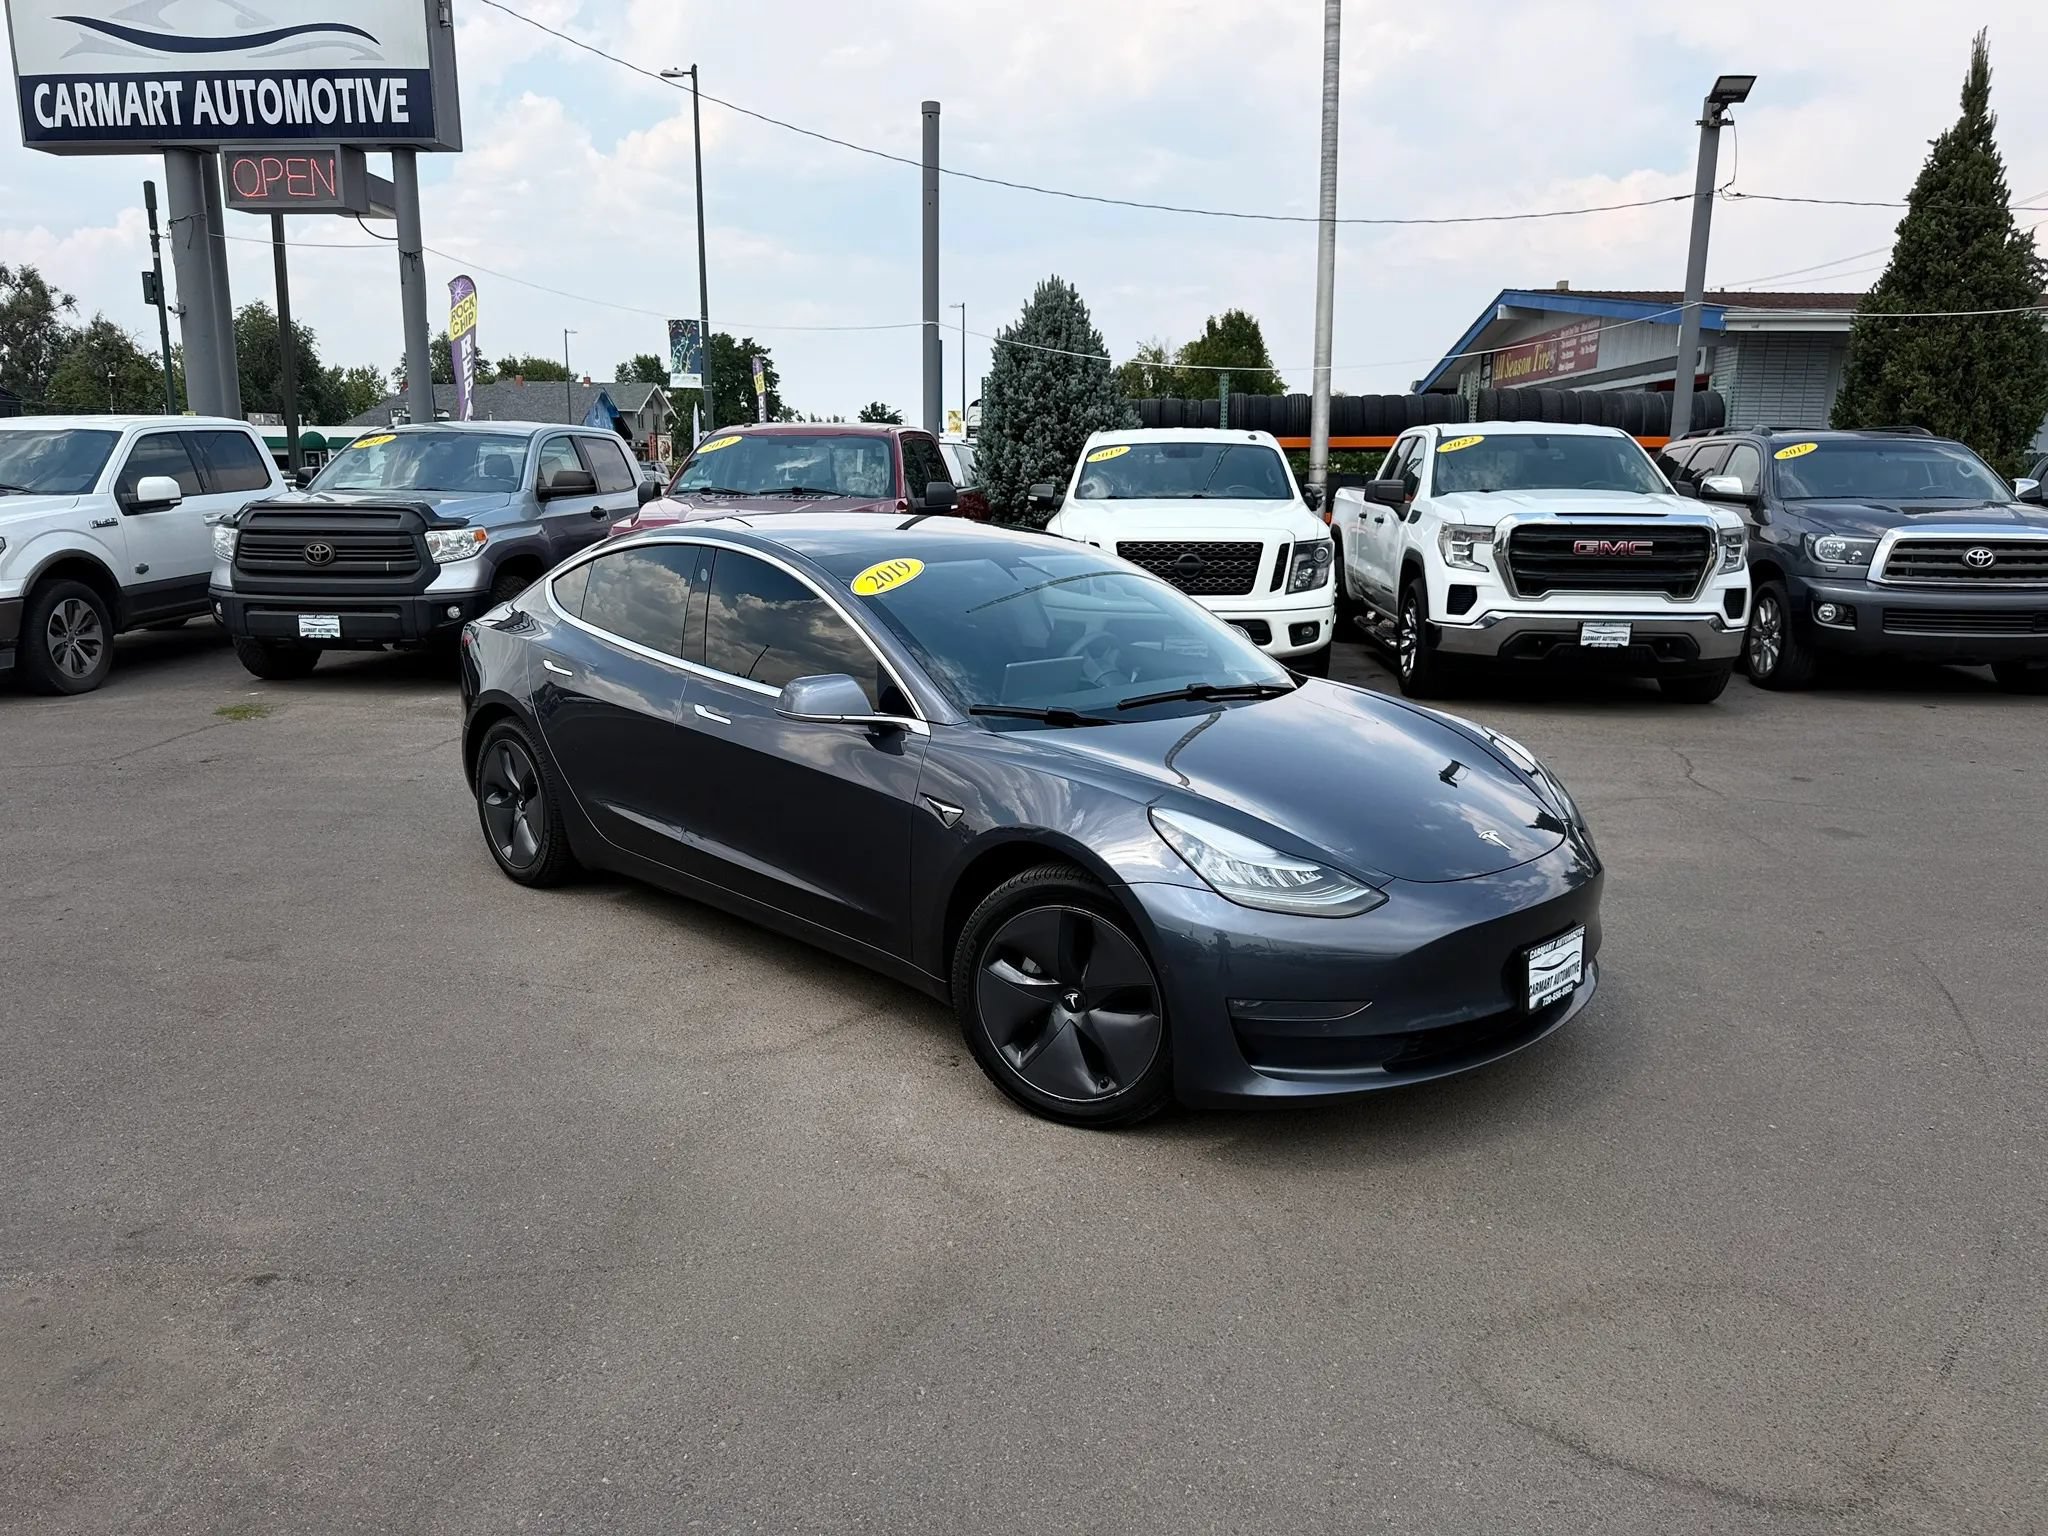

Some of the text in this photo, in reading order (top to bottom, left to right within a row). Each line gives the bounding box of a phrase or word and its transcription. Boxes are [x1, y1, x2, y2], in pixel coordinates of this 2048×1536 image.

[33, 78, 410, 128] CARMART AUTOMOTIVE
[232, 158, 335, 198] OPEN
[451, 299, 475, 323] ROCK
[452, 312, 474, 336] CHIP
[1505, 353, 1531, 378] Season
[1447, 437, 1475, 449] 2022
[1784, 444, 1808, 457] 2017
[1574, 540, 1653, 555] GMC
[865, 561, 911, 589] 2019
[1530, 926, 1586, 960] CARMART AUTOMOTIVE
[1529, 960, 1581, 997] CARMART AUTOMOTIVE
